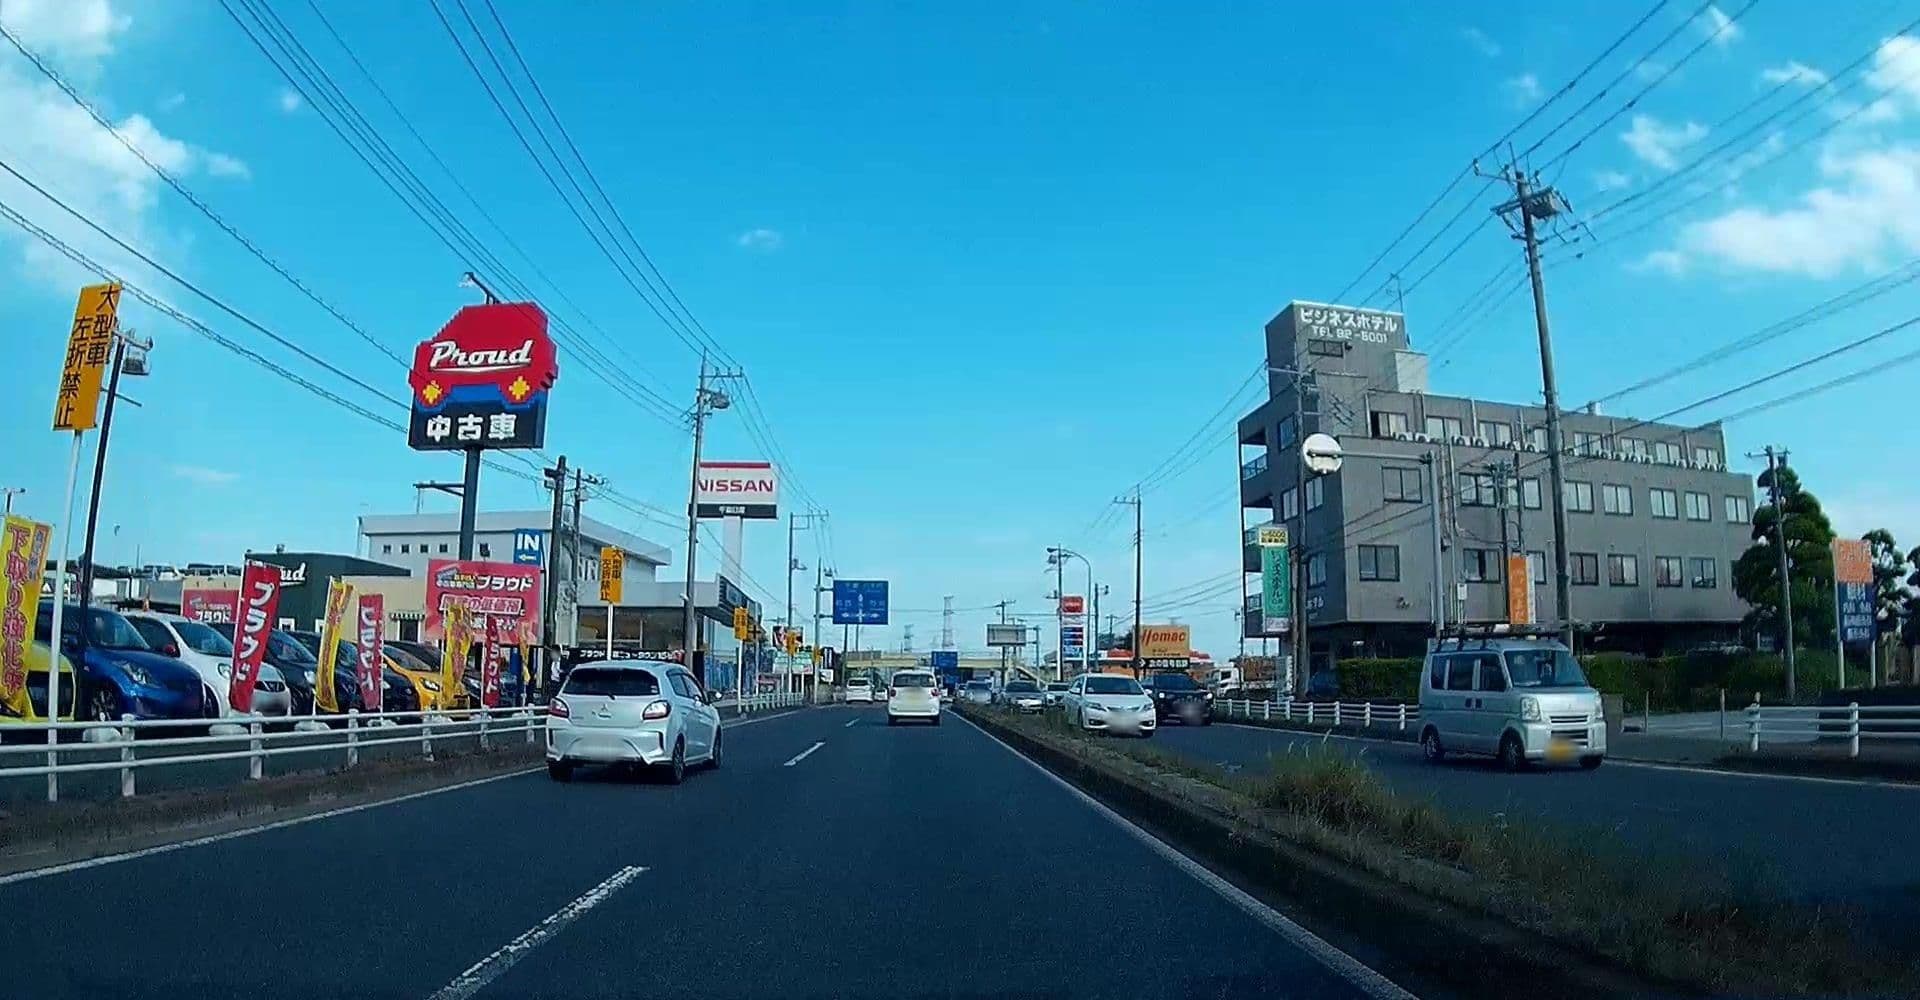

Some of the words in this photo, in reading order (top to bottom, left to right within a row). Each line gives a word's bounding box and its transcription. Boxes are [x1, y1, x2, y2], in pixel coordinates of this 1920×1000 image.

[85, 285, 121, 367] 大型車
[1300, 307, 1398, 333] ビジネスホテル
[1311, 325, 1334, 338] TEL
[430, 338, 534, 369] Proud
[54, 315, 92, 428] 左折禁止
[426, 411, 517, 442] 中古車
[698, 479, 773, 492] NISSAN
[516, 533, 540, 551] IN
[476, 575, 534, 592] プラウド
[239, 581, 274, 681] プラウド
